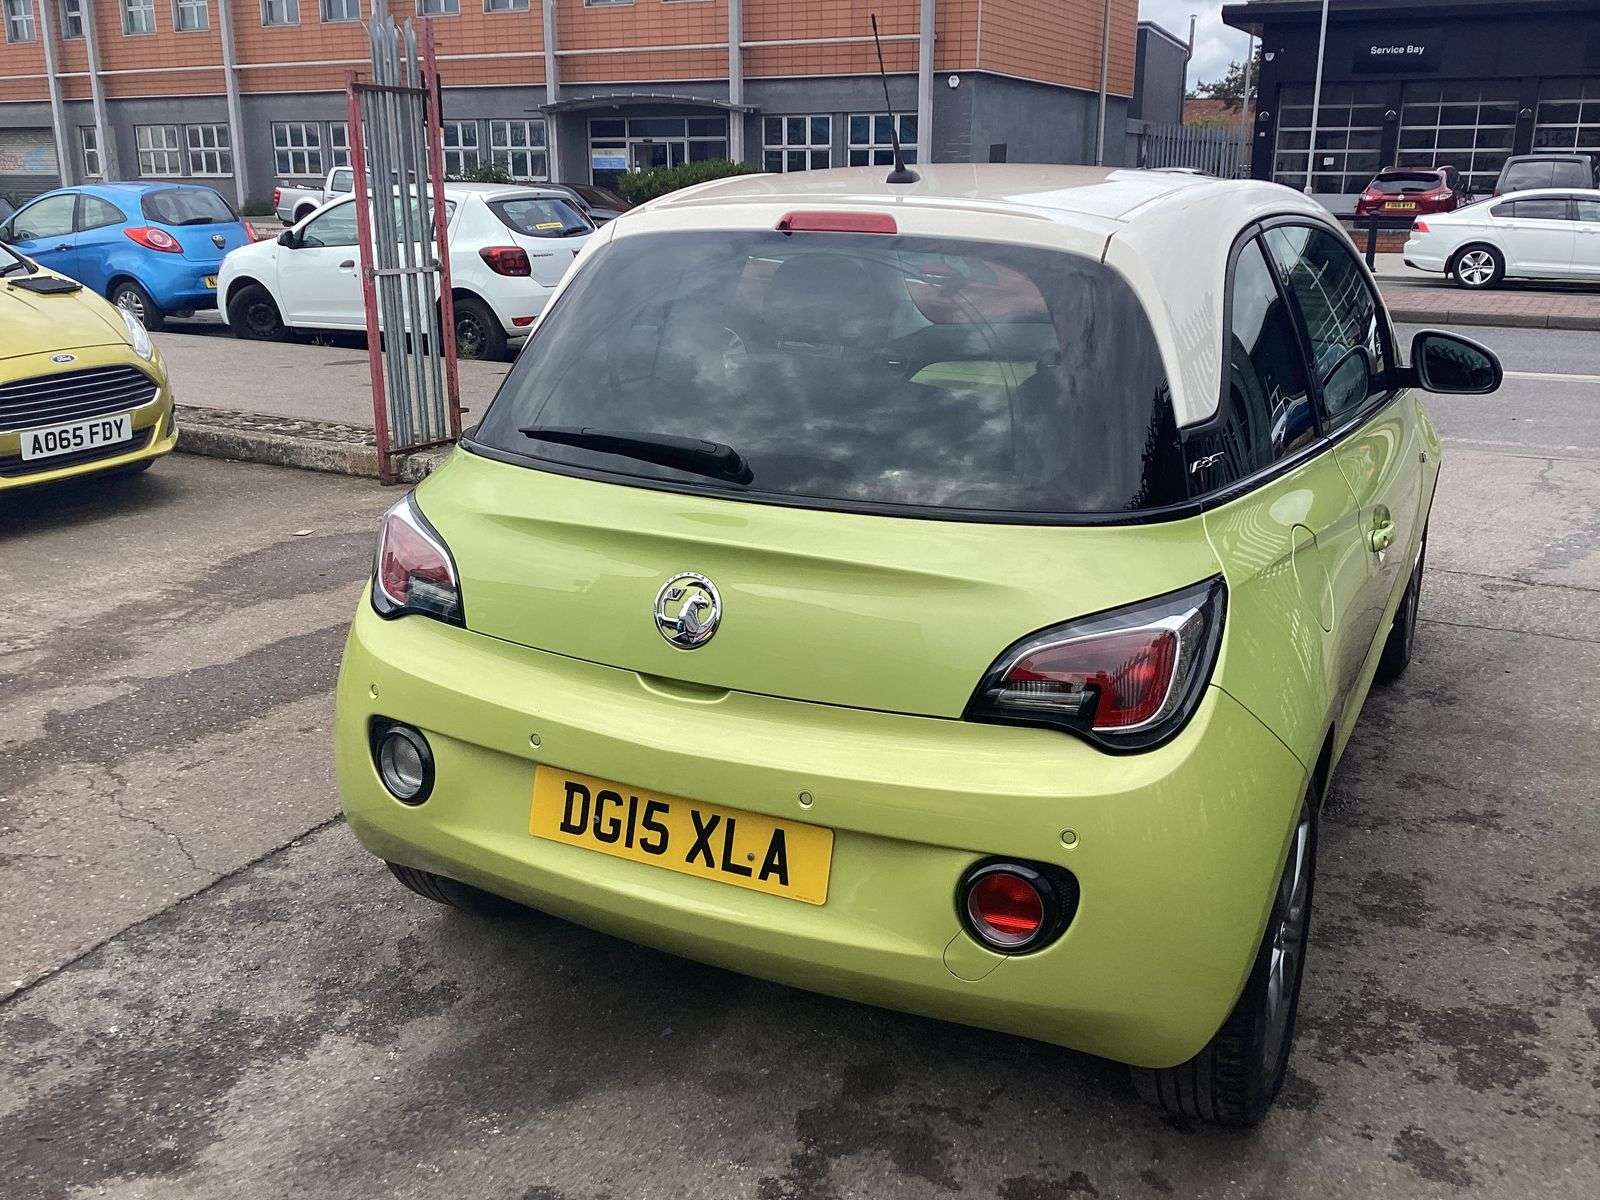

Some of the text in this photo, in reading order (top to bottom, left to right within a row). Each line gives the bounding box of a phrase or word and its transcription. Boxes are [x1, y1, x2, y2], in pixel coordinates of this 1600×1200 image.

[1370, 45, 1425, 55] Service Bay
[31, 418, 124, 455] AO65 FDY
[559, 780, 790, 887] DG15 XLA
